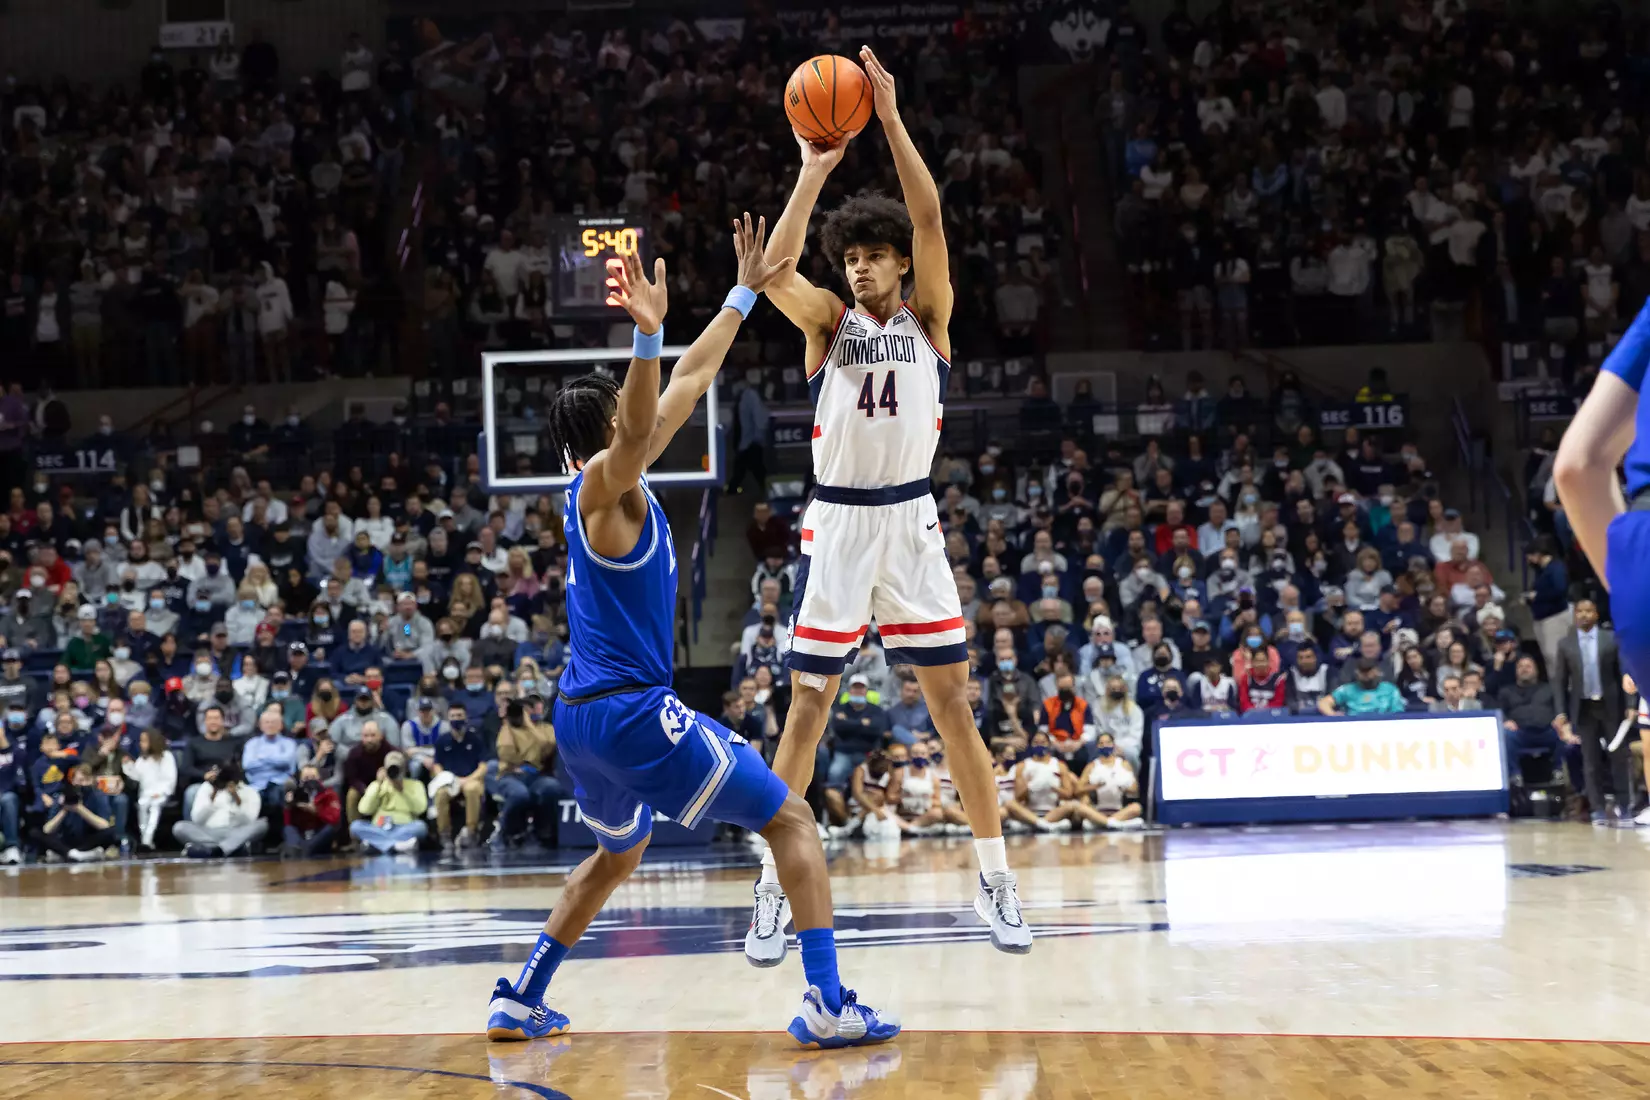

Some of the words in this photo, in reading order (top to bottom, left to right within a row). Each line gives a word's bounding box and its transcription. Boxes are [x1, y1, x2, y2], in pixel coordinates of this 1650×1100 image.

[581, 228, 639, 257] 5:40
[857, 369, 899, 418] 44
[1321, 409, 1350, 424] SEC
[1362, 404, 1404, 426] 116
[1529, 400, 1559, 415] SEC
[774, 427, 804, 442] SEC
[36, 453, 63, 468] SEC
[74, 449, 116, 471] 114
[1176, 748, 1235, 778] CT
[1292, 739, 1486, 774] DUNKIN'
